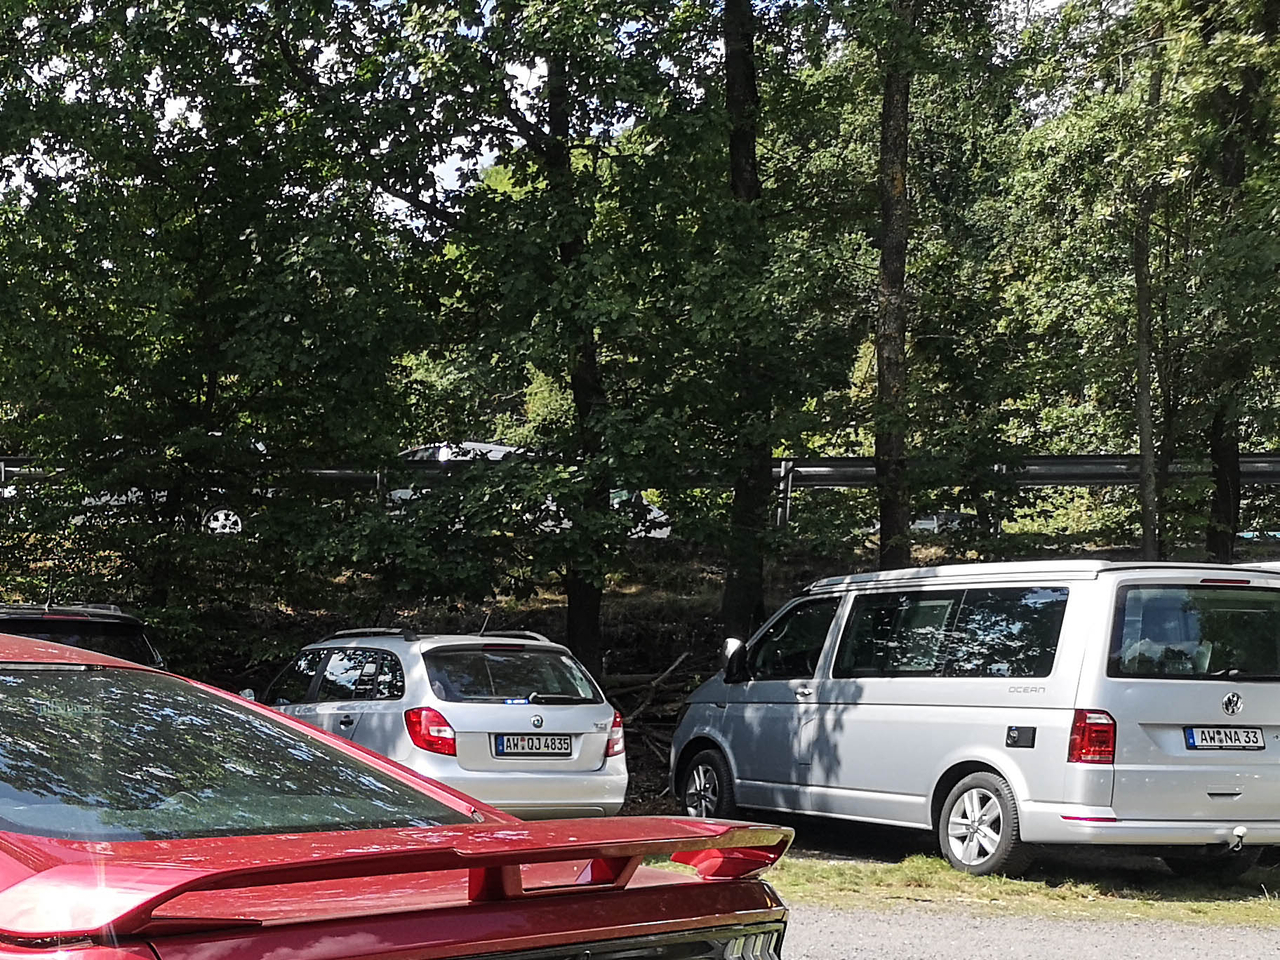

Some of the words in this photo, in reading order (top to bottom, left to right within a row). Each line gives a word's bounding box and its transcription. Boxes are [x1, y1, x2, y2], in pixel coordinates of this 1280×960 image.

[1008, 686, 1046, 694] OCEAN
[505, 737, 519, 751] AW
[527, 737, 541, 751] QJ
[543, 737, 569, 751] 4835
[1200, 730, 1216, 744] AW
[1224, 731, 1241, 744] NA
[1243, 731, 1259, 744] 33
